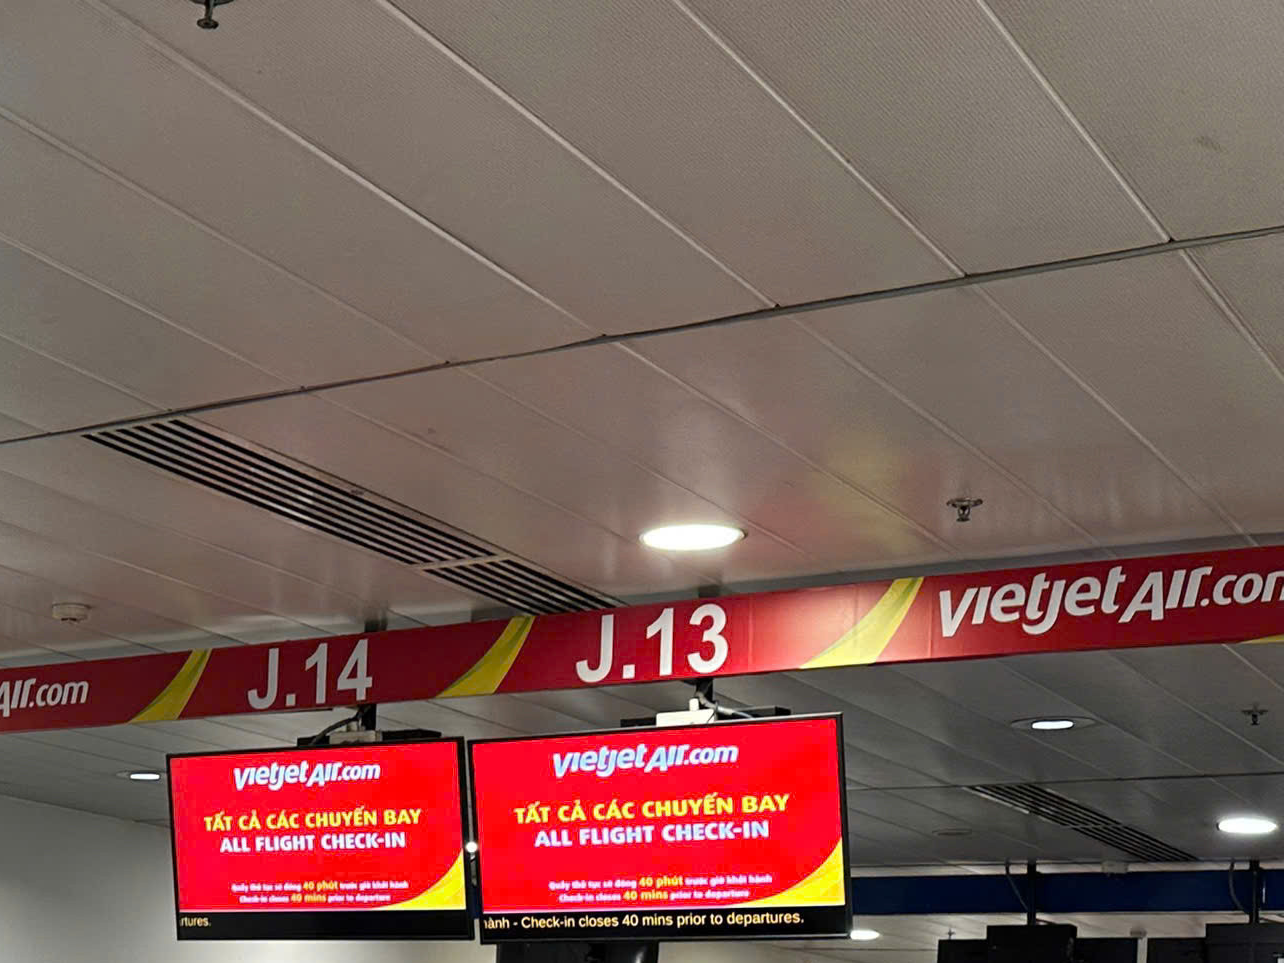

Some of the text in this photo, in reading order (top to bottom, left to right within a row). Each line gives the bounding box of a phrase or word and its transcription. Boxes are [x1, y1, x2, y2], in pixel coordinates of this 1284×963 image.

[576, 604, 729, 683] J.13
[247, 639, 373, 710] J.14
[384, 808, 422, 825] BAY
[593, 797, 635, 821] CÁC
[741, 793, 790, 813] BAY
[220, 832, 406, 853] ALL FLIGHT CHECK-IN
[534, 820, 769, 847] ALL FLIGHT CHECK-IN
[639, 876, 653, 887] 40
[623, 890, 638, 900] 40
[641, 889, 668, 900] mins
[521, 915, 576, 929] Check-in
[578, 914, 619, 928] closes
[622, 914, 639, 926] 40
[642, 912, 673, 926] mins
[677, 912, 707, 928] prior
[710, 913, 723, 925] to
[727, 911, 804, 927] departures.
